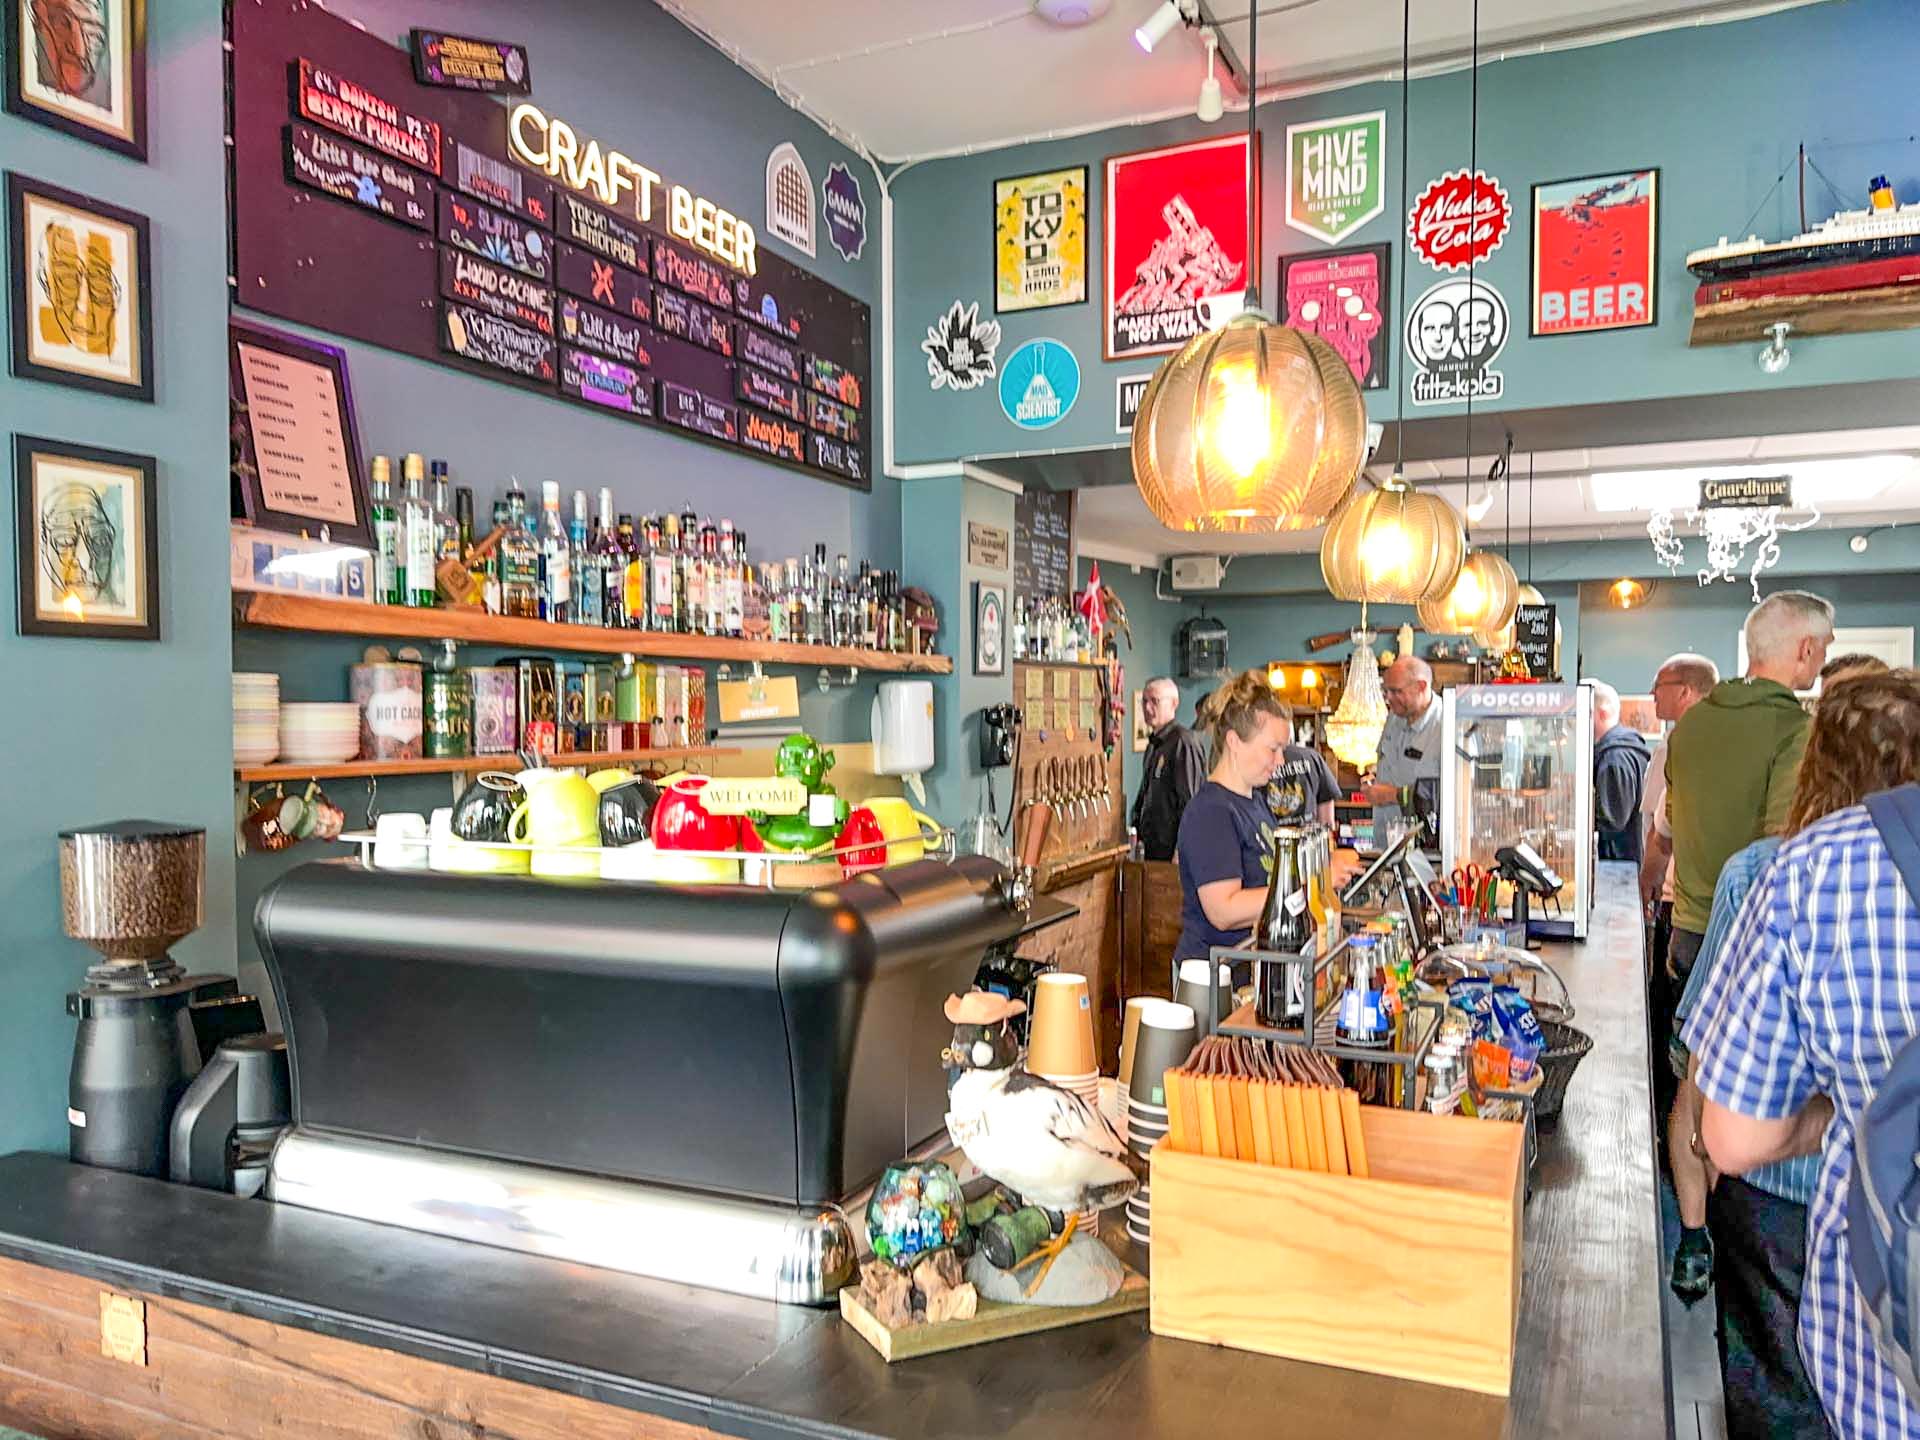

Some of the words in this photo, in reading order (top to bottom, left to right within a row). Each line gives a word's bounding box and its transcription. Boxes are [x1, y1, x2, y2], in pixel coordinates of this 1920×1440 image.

[307, 86, 364, 132] BERRY
[366, 114, 429, 164] PUDDING
[1302, 127, 1368, 169] HIVE
[509, 103, 661, 222] CRAFT
[667, 185, 757, 278] BEER
[1302, 167, 1367, 203] MIND
[566, 196, 608, 233] TOKYO
[1420, 188, 1498, 230] Nuka
[571, 217, 637, 267] LEMONADE
[1430, 220, 1494, 255] Cola
[455, 253, 499, 293] LIQUID
[498, 274, 550, 314] COCAINE
[1295, 268, 1327, 285] LIQUID
[1328, 263, 1370, 281] COCAINE
[1541, 283, 1646, 322] BEER
[1128, 328, 1160, 345] NOT
[1417, 367, 1498, 401] fritz-kola
[1016, 398, 1062, 421] SCIENTIST
[746, 412, 782, 456] Mango
[375, 705, 398, 722] HOT
[1471, 691, 1562, 708] POPCORN
[709, 790, 797, 805] WELCOME
